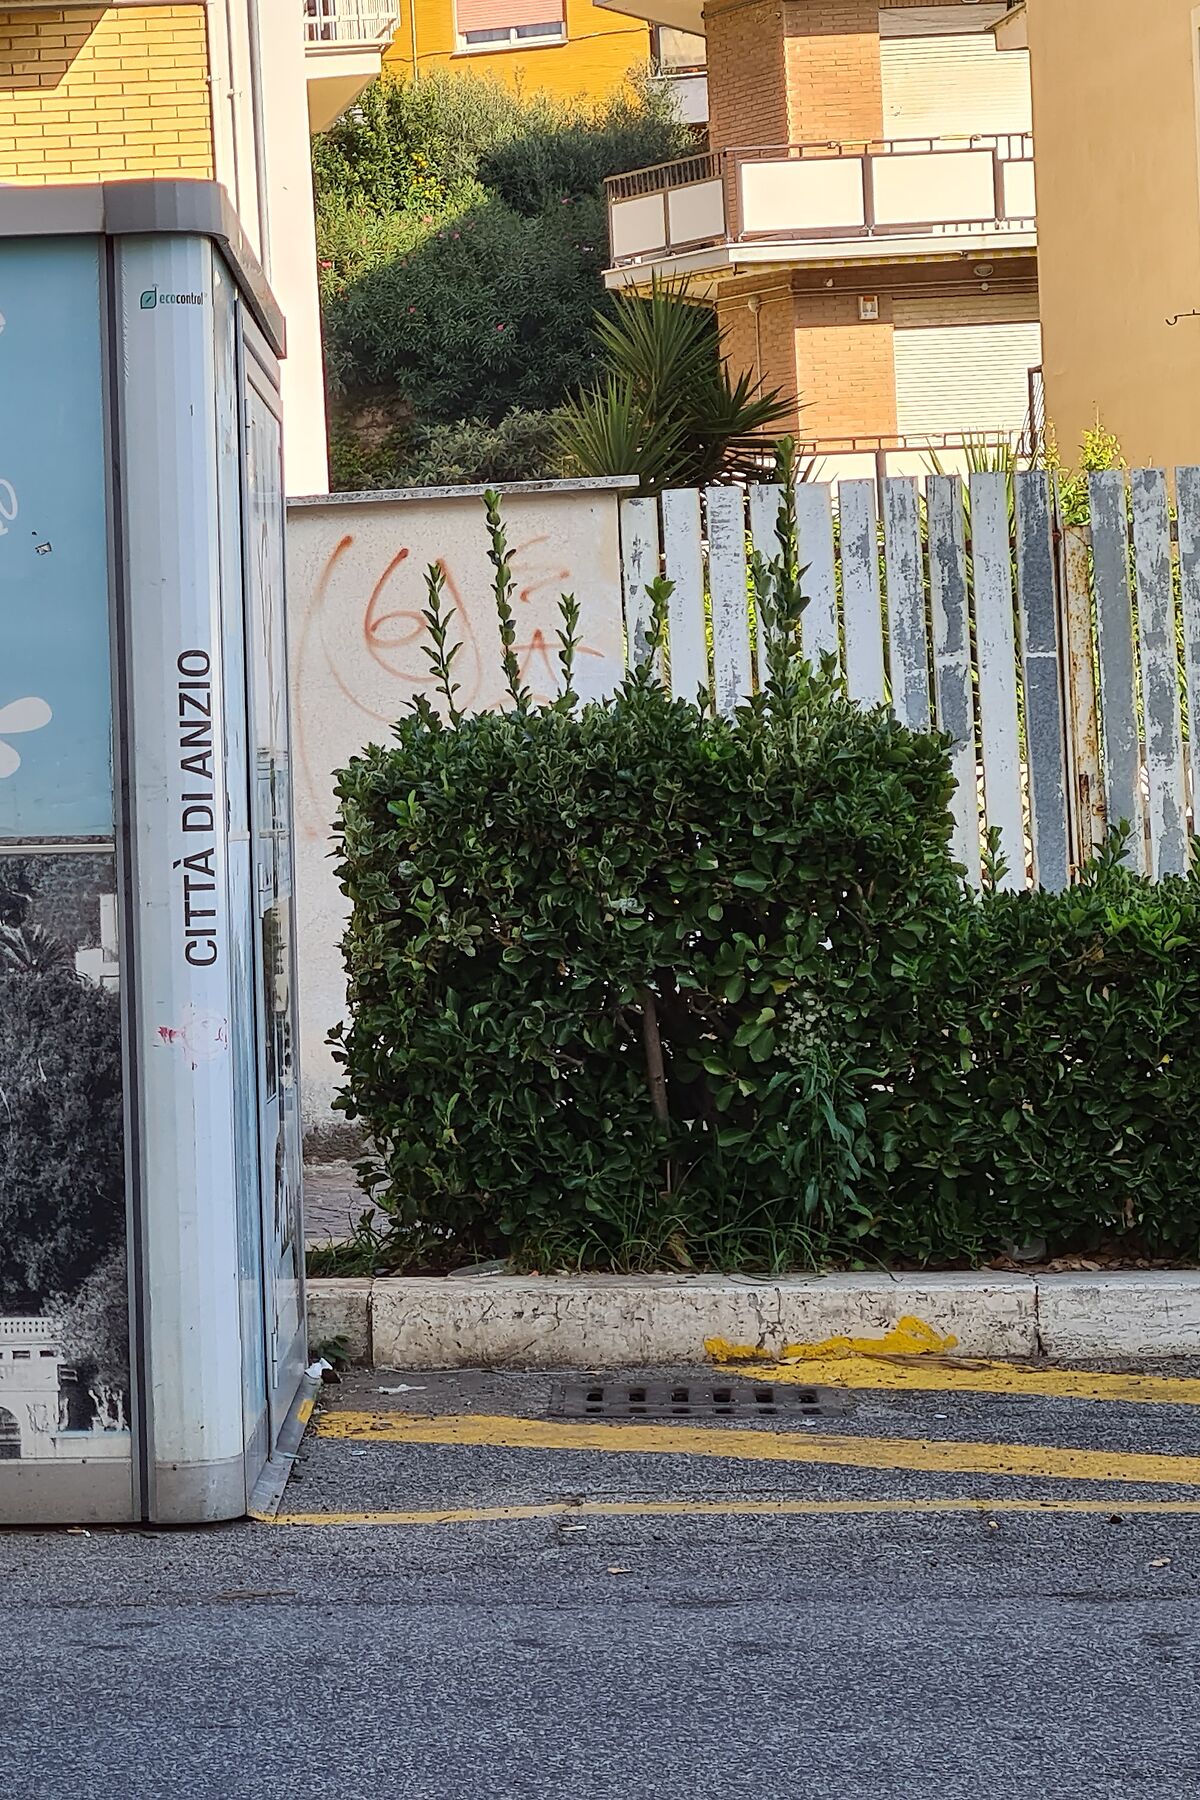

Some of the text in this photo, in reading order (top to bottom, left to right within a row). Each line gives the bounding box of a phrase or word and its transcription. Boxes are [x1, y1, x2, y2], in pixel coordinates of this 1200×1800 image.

[159, 292, 204, 305] ecocontrol
[173, 649, 218, 967] CITTÀ DI ANZIO
